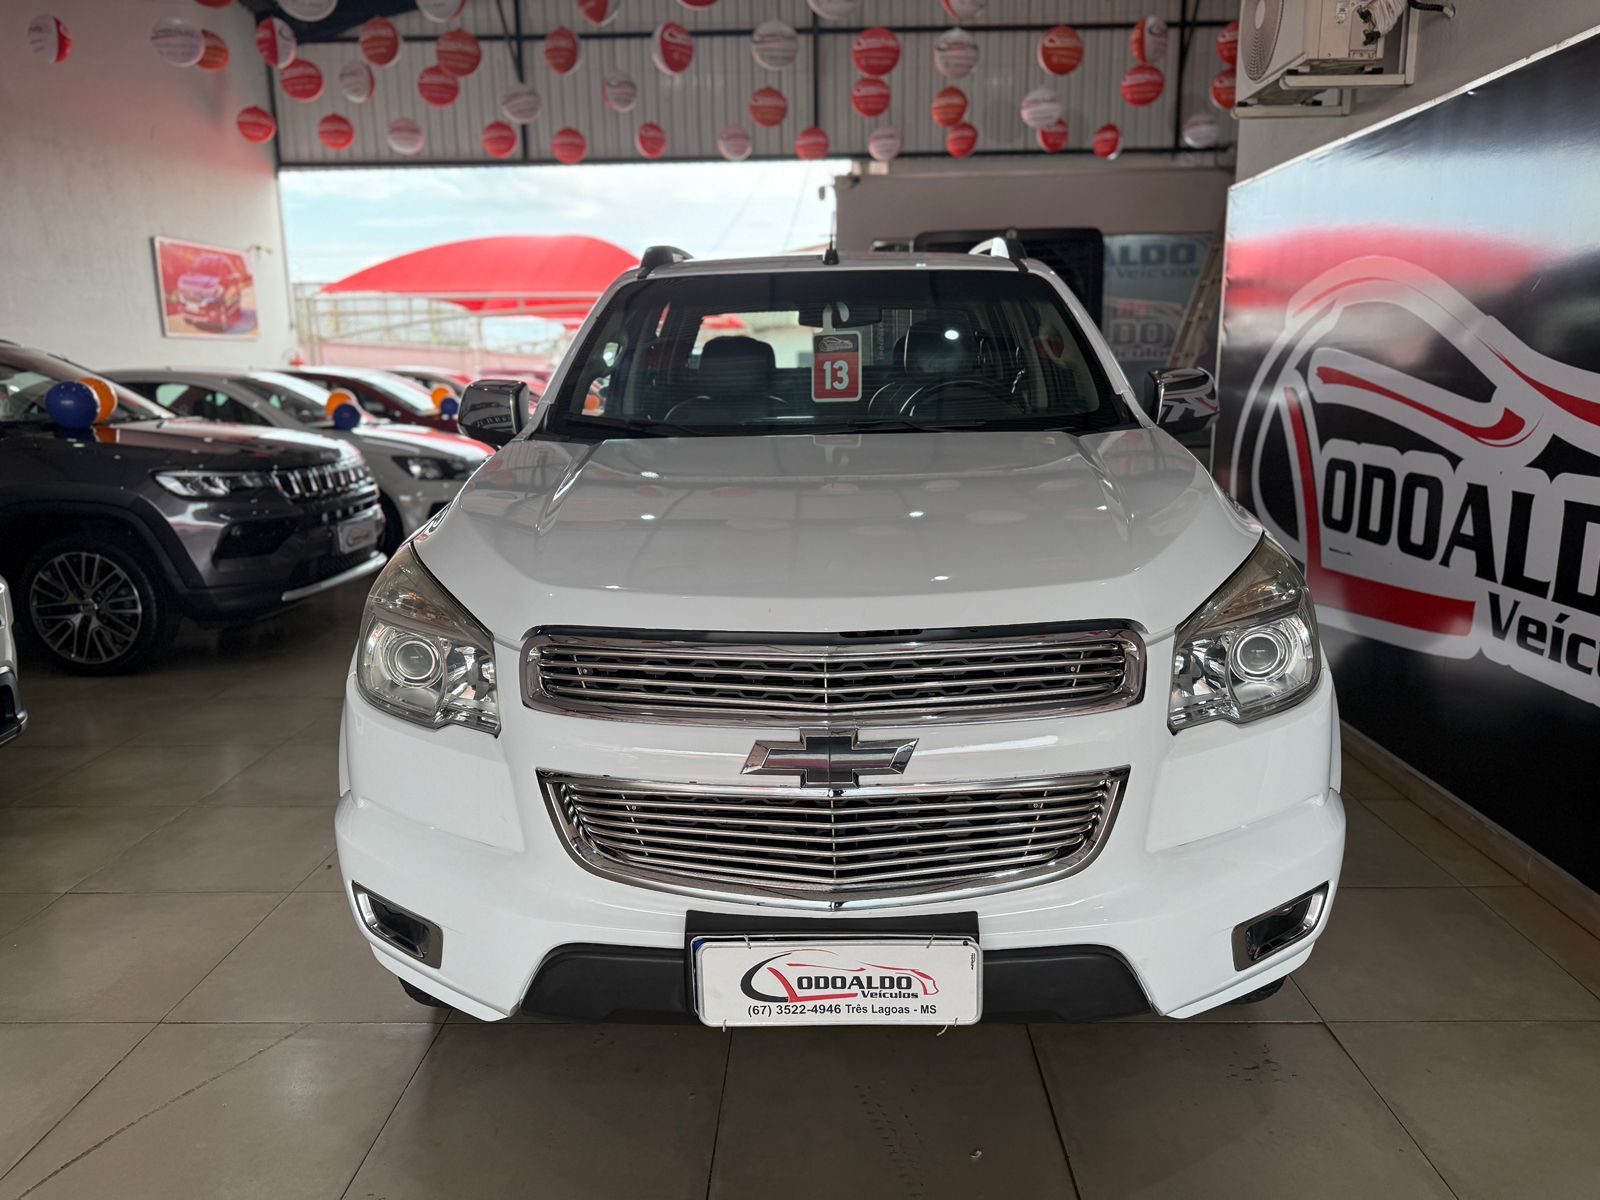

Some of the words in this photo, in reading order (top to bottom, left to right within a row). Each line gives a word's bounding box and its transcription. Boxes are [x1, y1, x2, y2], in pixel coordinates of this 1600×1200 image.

[823, 360, 849, 390] 13
[861, 988, 919, 999] Veículos
[748, 1005, 772, 1017] (67)
[776, 1004, 841, 1015] 3522-4946
[845, 1003, 868, 1014] Três
[871, 1003, 910, 1016] Lagoas
[921, 1004, 937, 1014] MS
